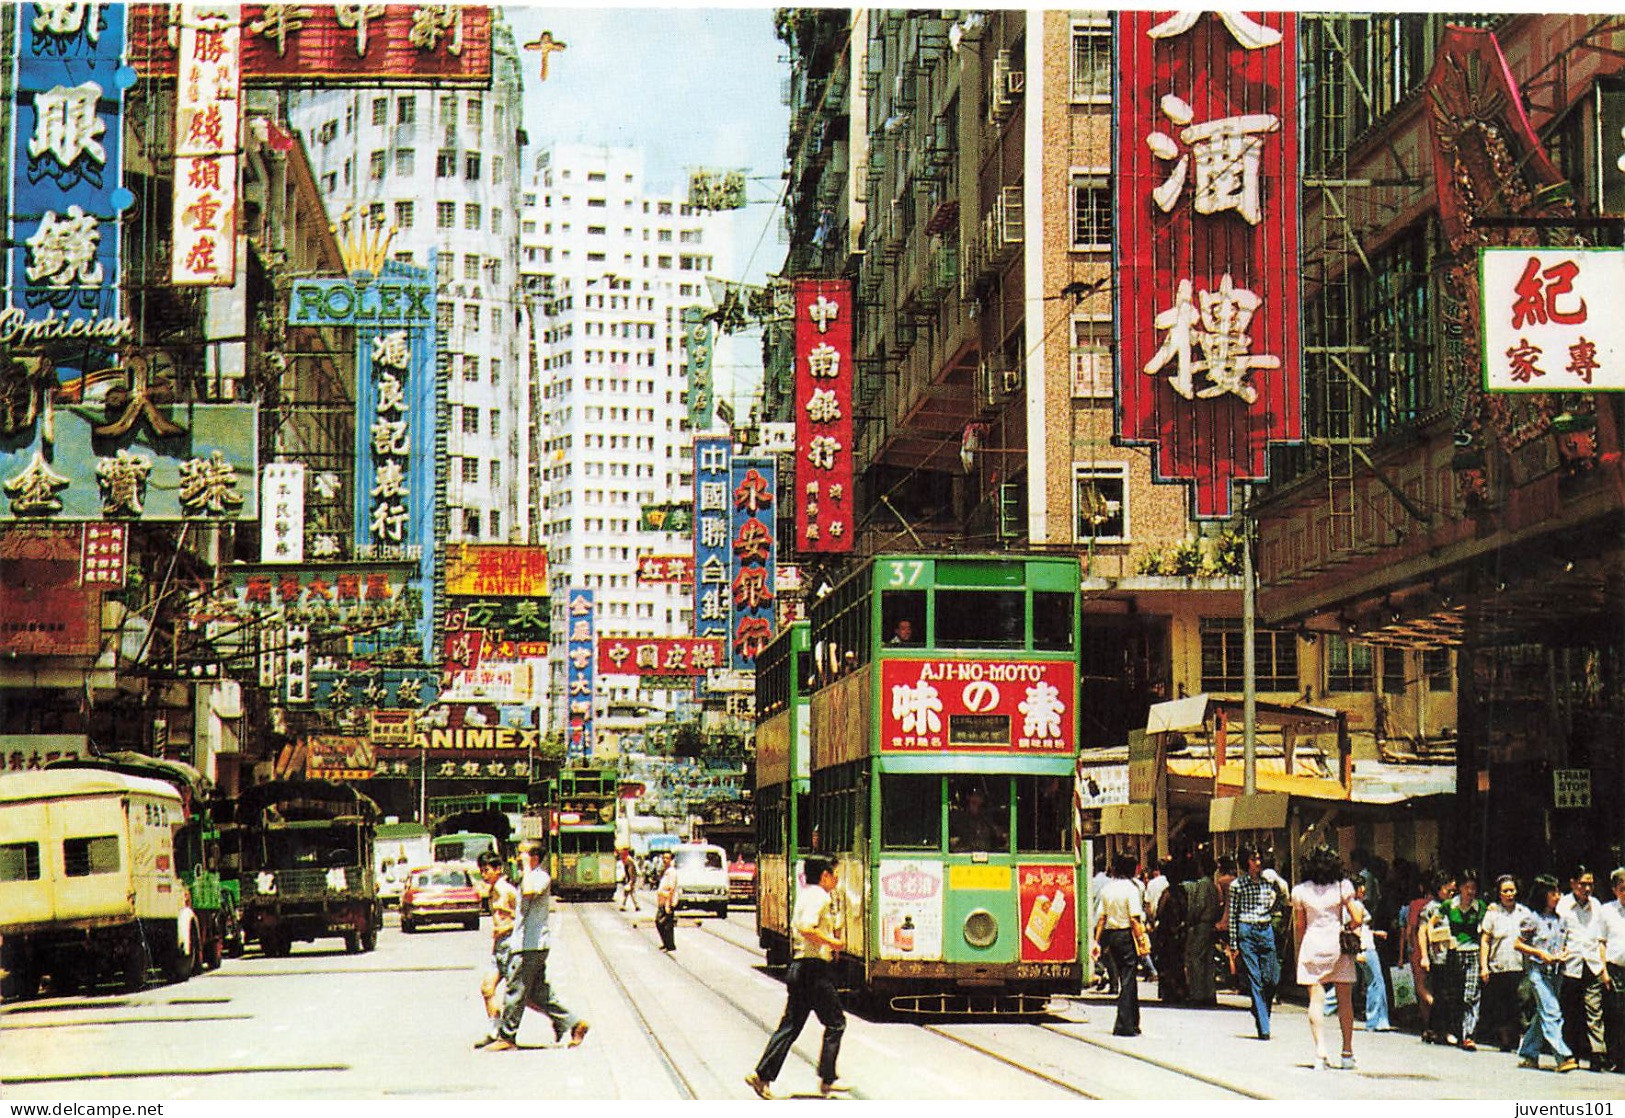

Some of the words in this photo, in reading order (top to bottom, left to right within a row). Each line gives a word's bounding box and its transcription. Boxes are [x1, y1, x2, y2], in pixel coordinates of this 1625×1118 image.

[297, 284, 432, 320] ROLEX
[0, 307, 135, 346] Optician
[806, 295, 842, 470] 中南銀行
[889, 561, 923, 586] 37
[920, 663, 1042, 681] AJI-NO-MOTO
[891, 680, 1066, 738] 味の素
[384, 729, 539, 749] ANIMEX
